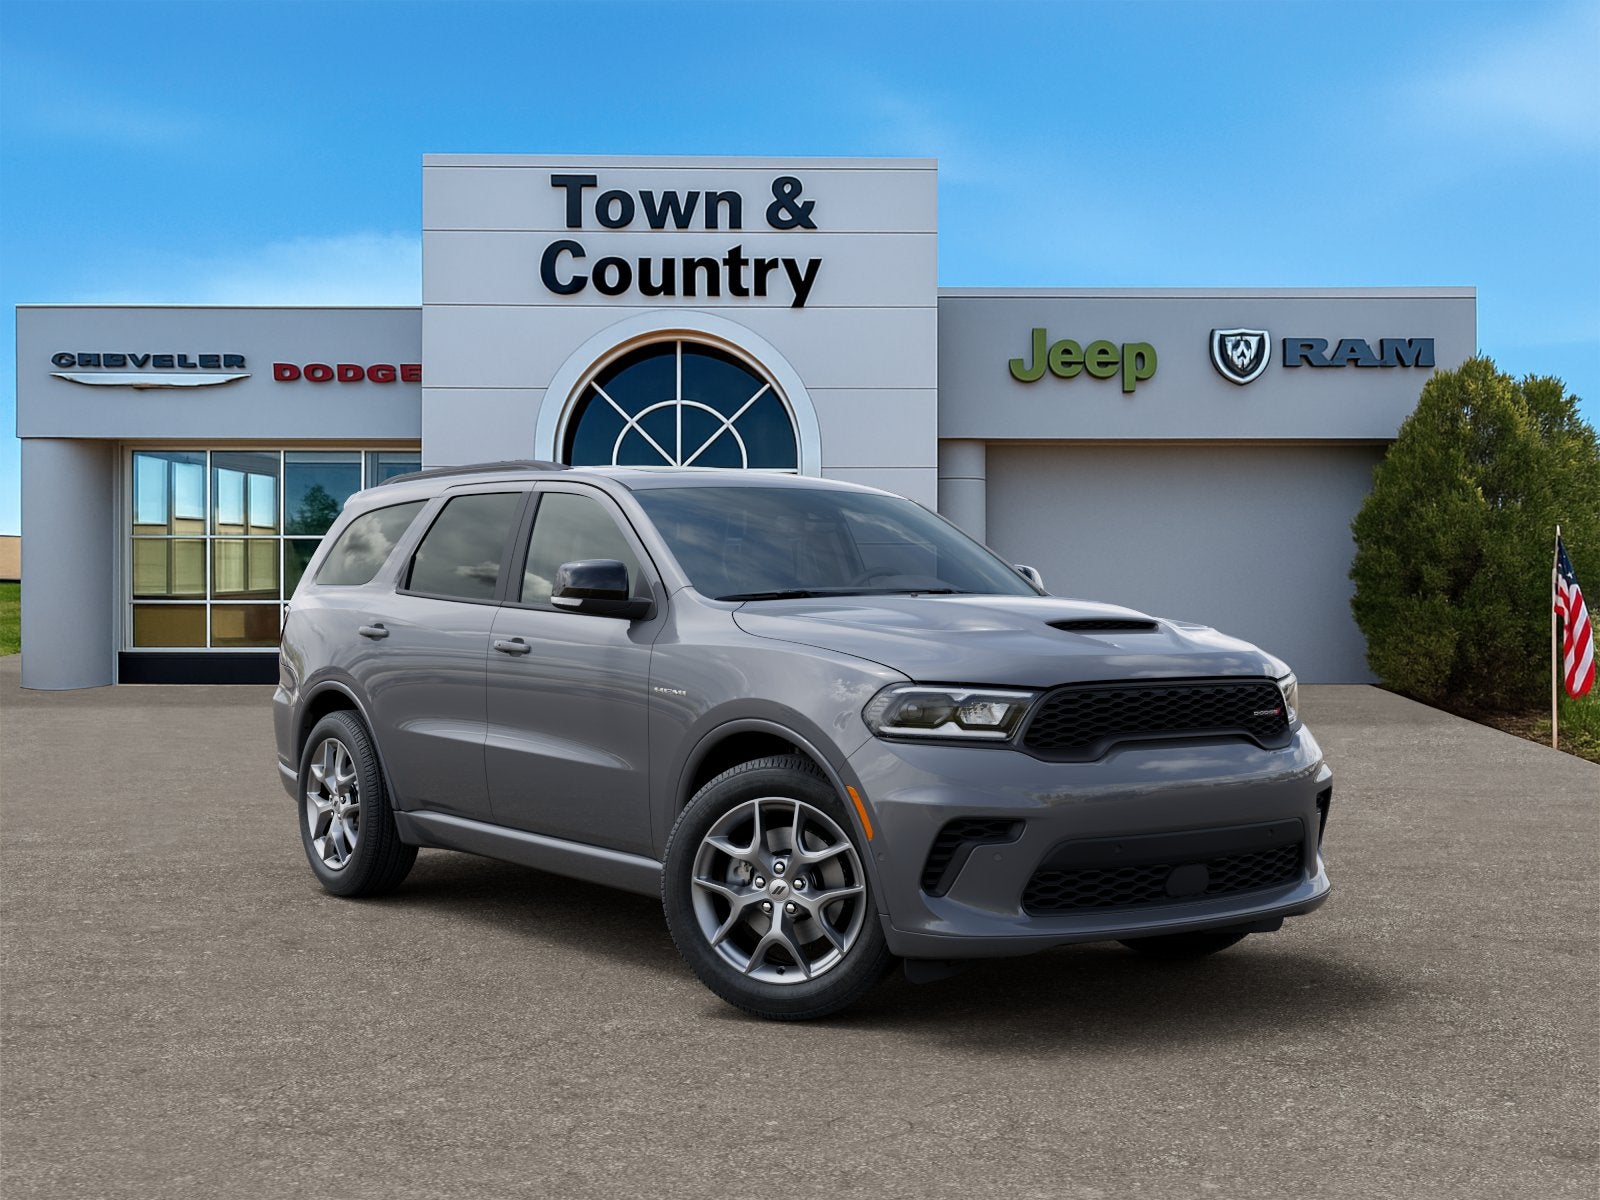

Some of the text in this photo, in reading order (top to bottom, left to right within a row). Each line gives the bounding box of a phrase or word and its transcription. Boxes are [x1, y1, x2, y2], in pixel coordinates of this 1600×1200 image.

[550, 174, 818, 230] Town &
[539, 239, 823, 308] Country
[272, 362, 422, 383] DODGE
[1009, 327, 1158, 393] Jeep
[1283, 337, 1435, 368] RAM
